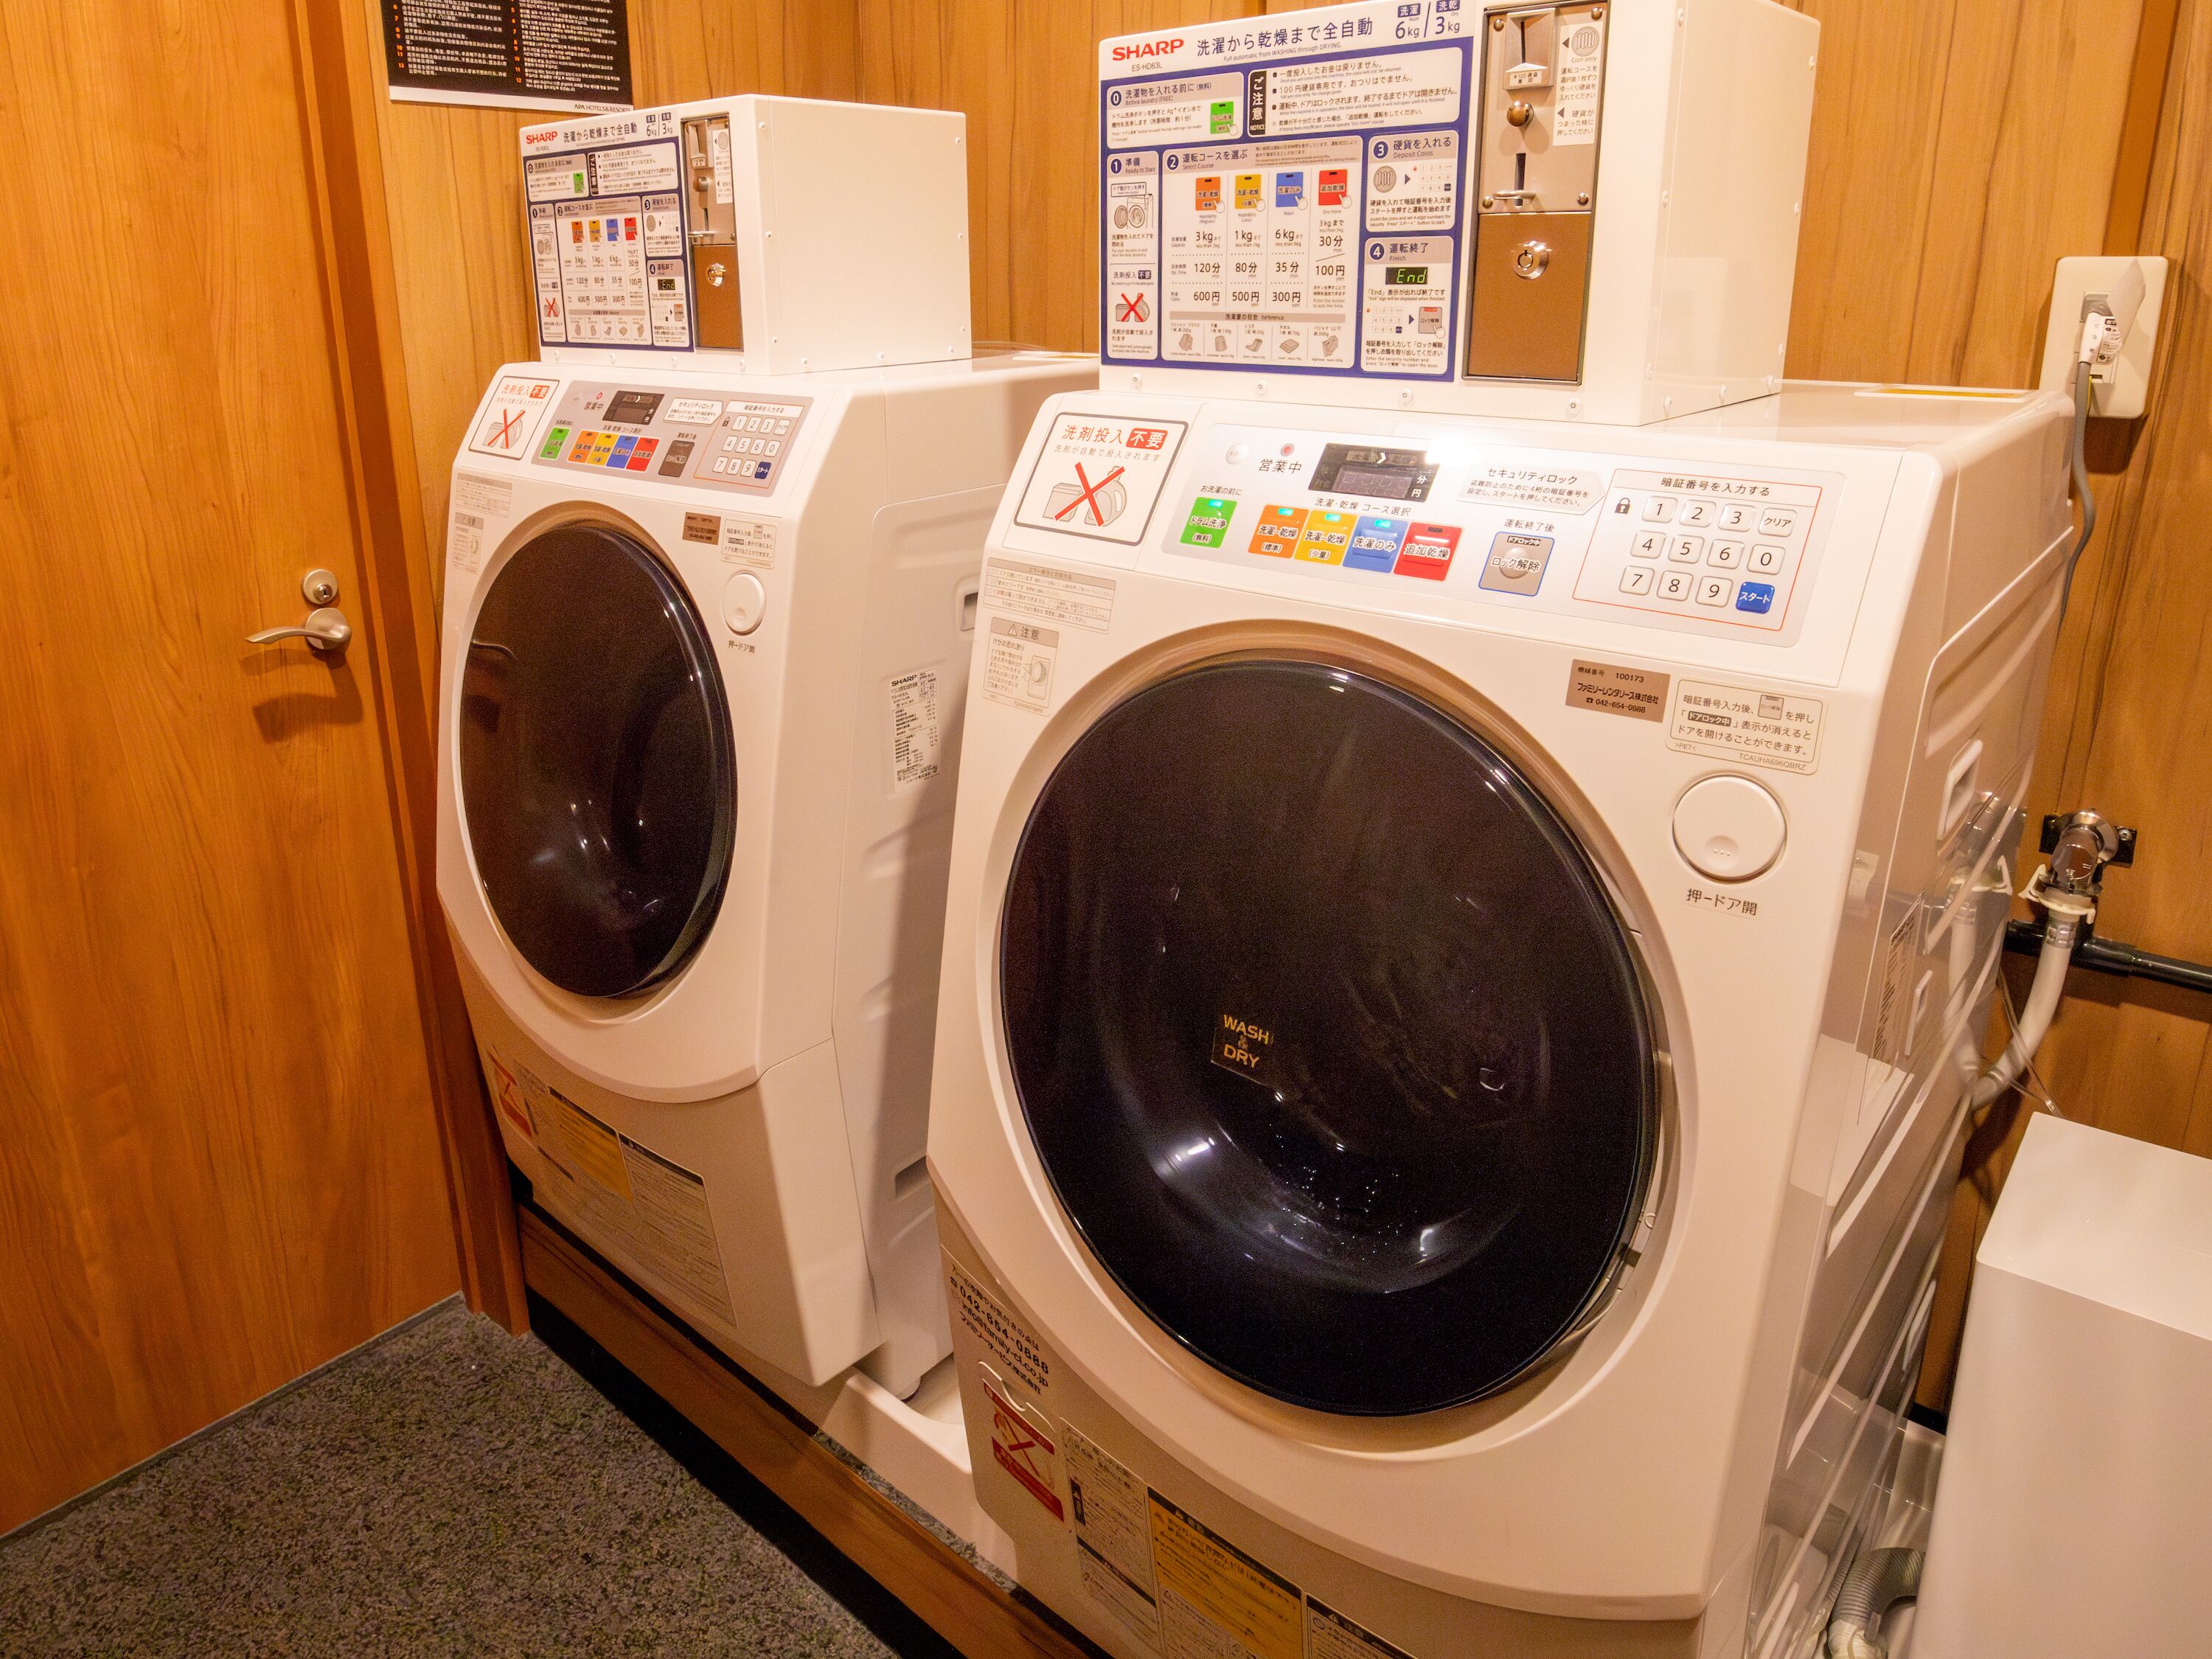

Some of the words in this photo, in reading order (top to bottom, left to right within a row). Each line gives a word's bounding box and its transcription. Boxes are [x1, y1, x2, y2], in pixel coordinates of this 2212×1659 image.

[1197, 17, 1373, 57] 洗濯から乾燥まで全自動
[1577, 32, 1595, 50] 100
[1113, 39, 1184, 60] SHARP
[1233, 52, 1257, 61] automatic
[1273, 47, 1296, 56] WASHING
[1298, 46, 1318, 55] through
[1132, 63, 1162, 72] ES-HD63L
[1280, 62, 1382, 77] 一度投入したお金は戻りません。
[1561, 65, 1598, 74] 運転コースを
[1125, 83, 1194, 99] 洗濯物を入れる前に
[1560, 83, 1596, 92] ゆっくり硬貨を
[1251, 76, 1265, 122] ご注意
[1559, 92, 1596, 101] 入れてください
[1572, 109, 1594, 117] 硬貨が
[1557, 119, 1593, 128] つまった時に
[526, 131, 557, 144] SHARP
[563, 122, 637, 143] 洗濯から乾燥まで全自動
[1557, 128, 1593, 136] 押してください
[1394, 137, 1451, 150] 硬貨を入れる
[1125, 158, 1140, 166] 準備
[1183, 149, 1248, 163] 運転コースを選ぶ
[1377, 170, 1393, 187] 100
[1370, 197, 1451, 206] 硬貨を入れて暗証番号を入力後
[1371, 206, 1450, 215] スタートを押すと運転を始めます
[1320, 236, 1343, 246] 30分
[1390, 243, 1428, 254] 運転終了
[1194, 262, 1220, 273] 120分
[1235, 262, 1256, 273] 80分
[1276, 262, 1299, 273] 35分
[1315, 265, 1345, 276] 100円
[1397, 268, 1427, 283] End
[1194, 292, 1220, 302] 600円
[1233, 292, 1259, 302] 500円
[1272, 292, 1301, 302] 300円
[532, 386, 549, 398] 不要
[678, 401, 714, 409] セキュリティロック
[744, 405, 785, 414] 暗証番号を入力する
[750, 420, 755, 428] 2
[1062, 425, 1123, 445] 洗剤投入
[1130, 430, 1164, 448] 不要
[1053, 444, 1161, 463] 洗剤が自動で投入されます
[718, 460, 723, 468] 7
[731, 462, 737, 470] 8
[745, 464, 751, 472] 9
[1258, 459, 1303, 476] 営業中
[1416, 474, 1427, 484] 分
[1486, 467, 1578, 484] セキュリティロック
[1200, 484, 1243, 496] お洗濯の前に
[1411, 488, 1422, 498] 円
[1470, 479, 1590, 498] 盗難防止のために4桁の暗証番号を
[1660, 476, 1770, 497] 暗証番号を入力する
[1467, 487, 1581, 506] 設定し、スタートを押してください。
[1362, 503, 1411, 516] コース選択
[1656, 503, 1663, 516] 1
[1691, 506, 1703, 520] 2
[1731, 511, 1741, 525] 3
[1764, 517, 1792, 529] クリア
[1189, 515, 1227, 529] ドラム洗浄
[1504, 518, 1554, 532] 運転終了後
[1354, 536, 1397, 553] 洗濯のみ
[1507, 536, 1541, 546] ドアロック中
[1405, 543, 1450, 560] 追加乾燥
[1643, 538, 1653, 552] 4
[1680, 542, 1691, 555] 5
[1719, 546, 1730, 561] 6
[1760, 552, 1772, 566] 0
[1491, 556, 1540, 572] ロック解除
[1633, 573, 1644, 587] 7
[1669, 578, 1680, 593] 8
[1708, 584, 1720, 598] 9
[1739, 591, 1770, 604] スタート
[1020, 626, 1040, 640] 注意
[992, 637, 1025, 650] けがの恐れあり
[891, 674, 917, 686] SHARP
[1577, 666, 1605, 677] 機械番号
[1615, 672, 1644, 684] 100173
[1683, 694, 1754, 714] 暗証番号入力後、
[1785, 712, 1815, 724] を押し
[1740, 720, 1812, 740] 表示が消えると
[1678, 724, 1807, 757] ドアを開けることができます。
[1223, 1014, 1269, 1045] WASH
[1224, 1044, 1259, 1068] DRY
[959, 1285, 1048, 1374] 042-654-0888
